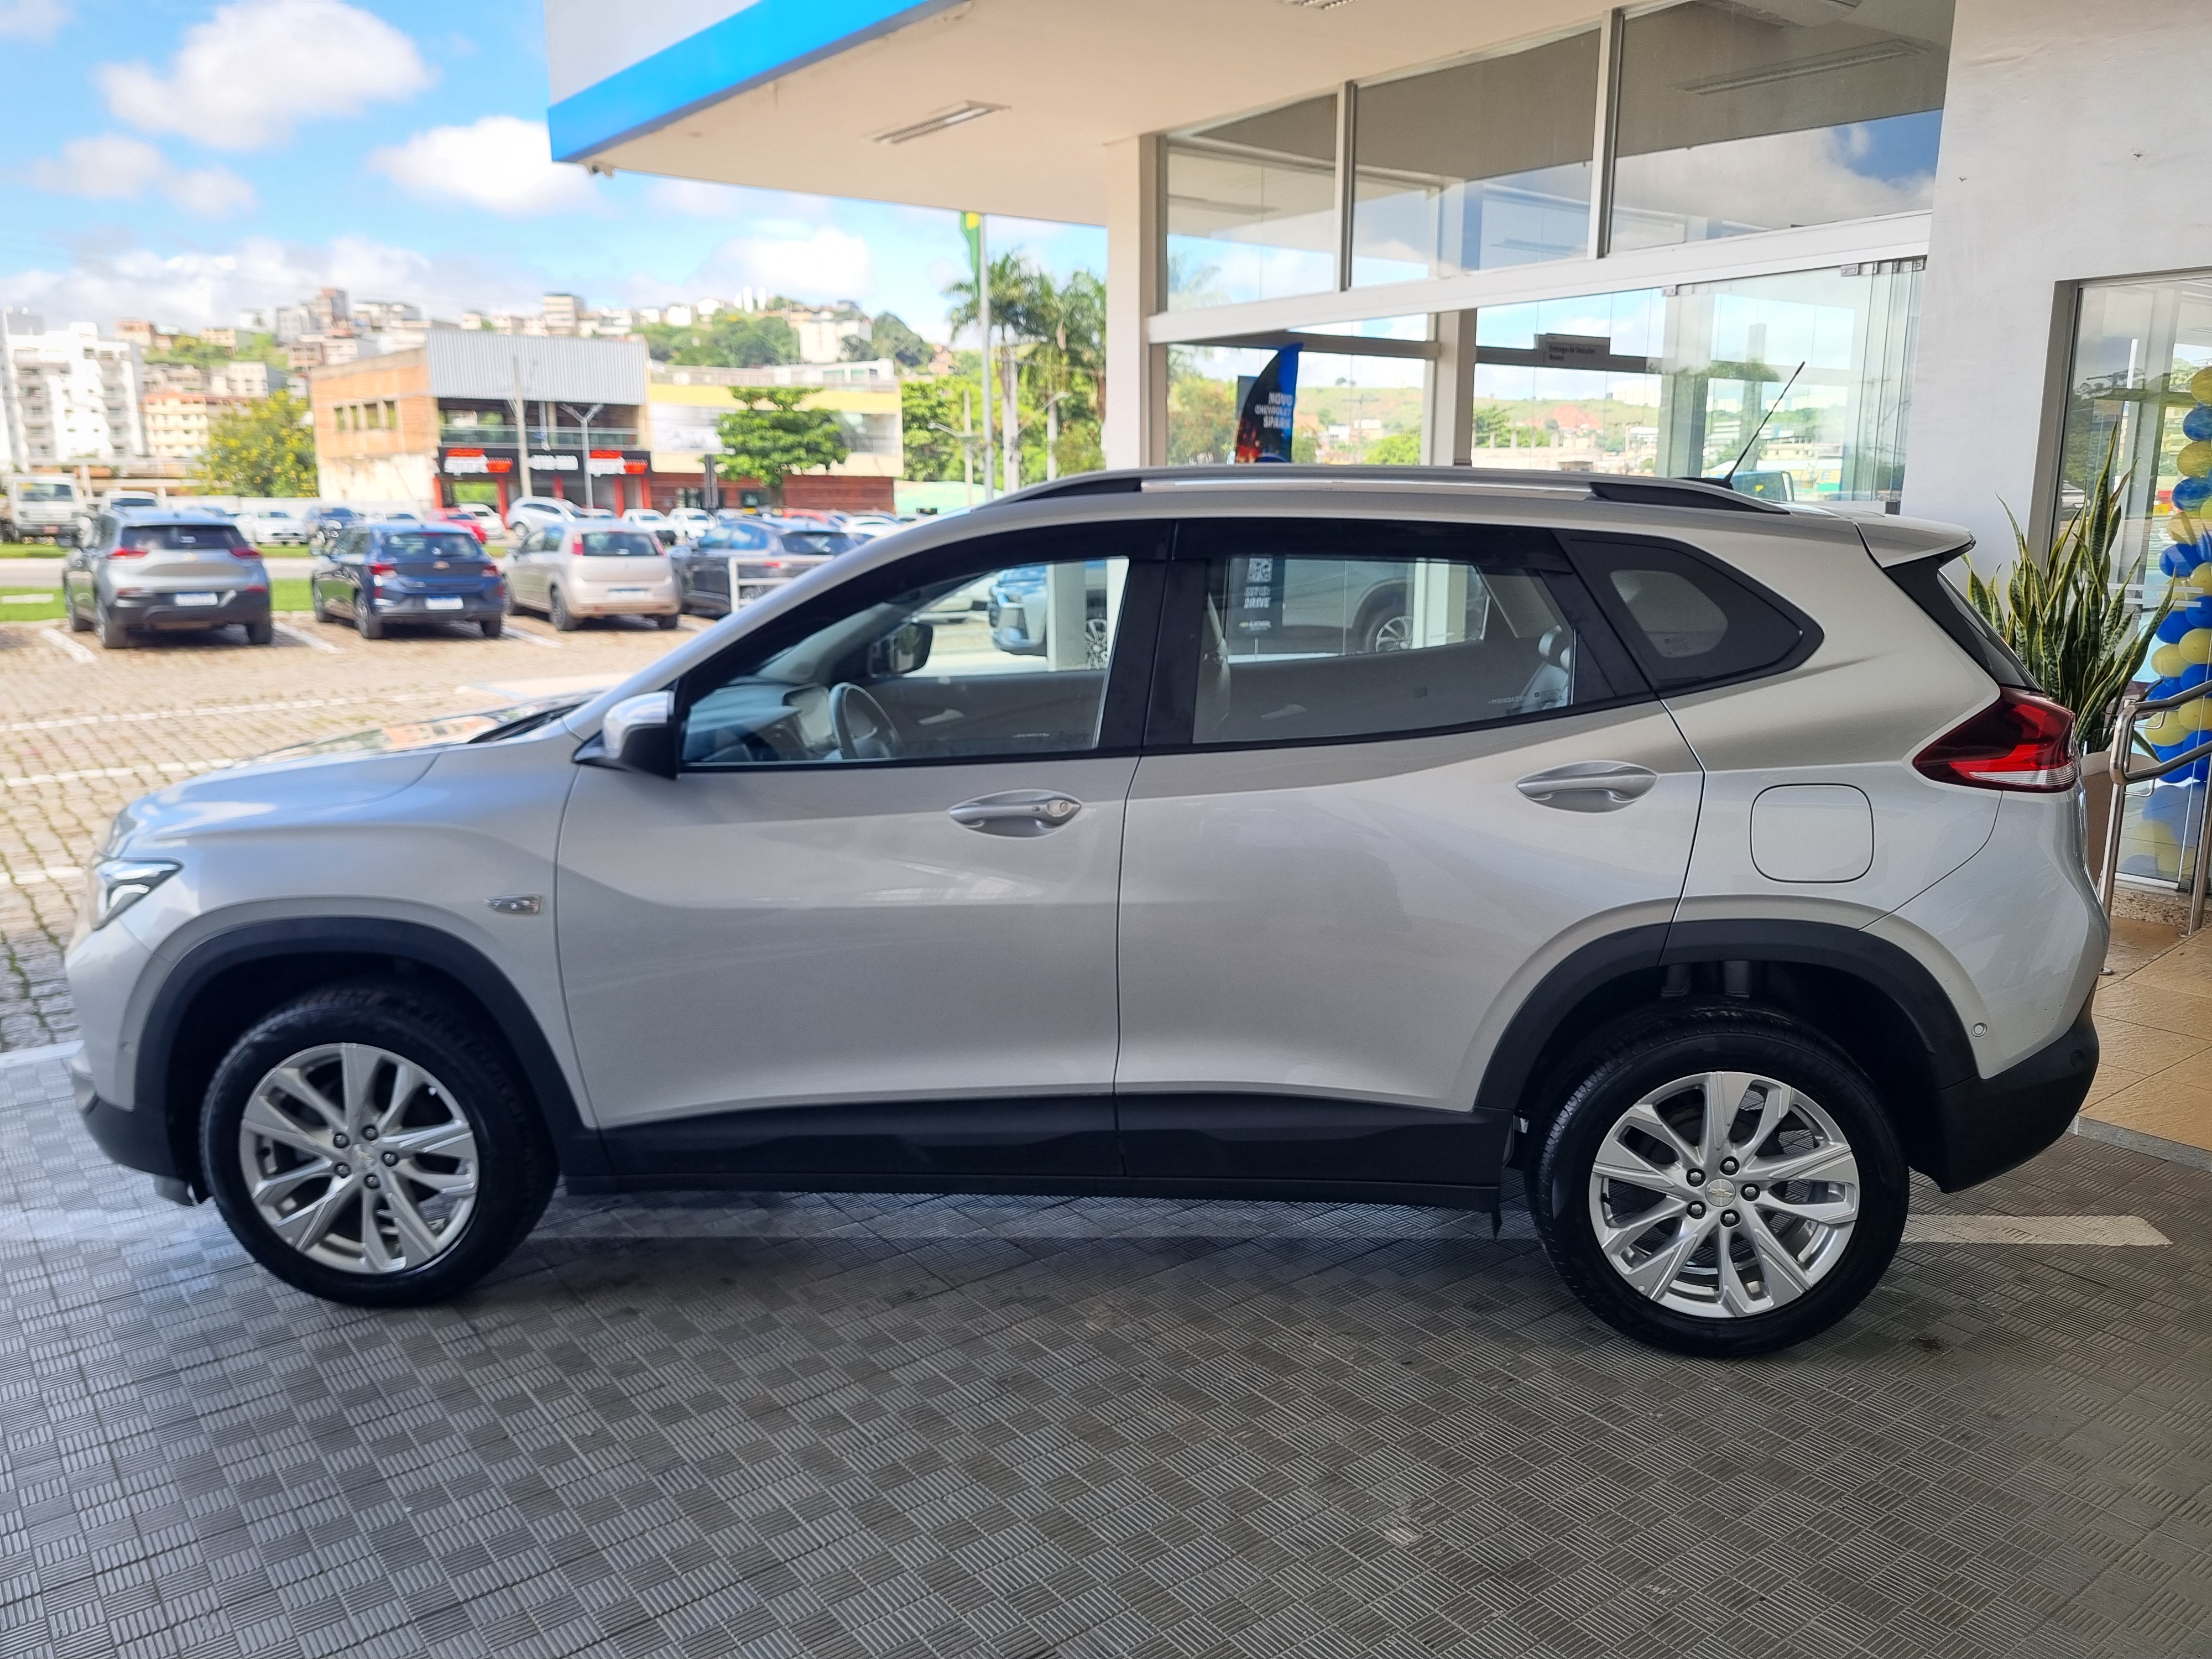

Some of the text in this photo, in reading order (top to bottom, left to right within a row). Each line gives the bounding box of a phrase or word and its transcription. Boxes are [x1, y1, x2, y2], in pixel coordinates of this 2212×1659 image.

[1268, 392, 1293, 406] NOVO
[1254, 404, 1292, 416] CHEVROLET
[1263, 416, 1292, 430] SPARK
